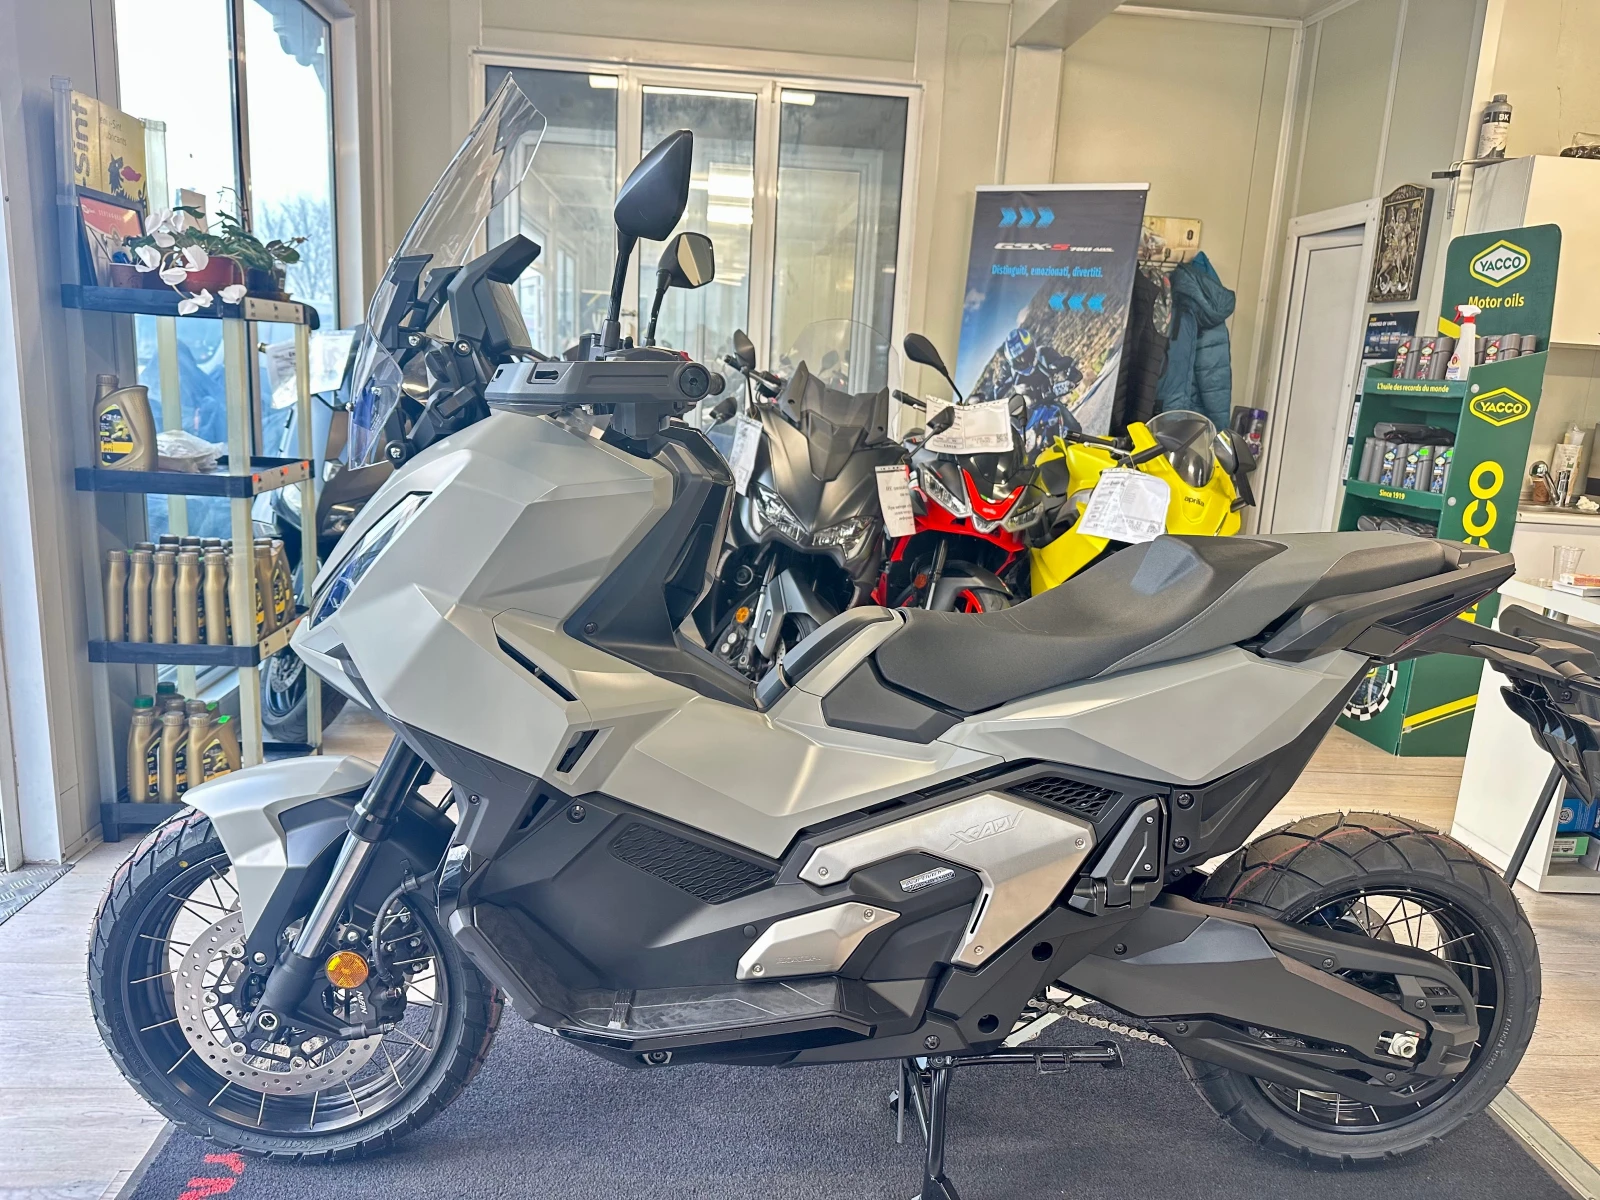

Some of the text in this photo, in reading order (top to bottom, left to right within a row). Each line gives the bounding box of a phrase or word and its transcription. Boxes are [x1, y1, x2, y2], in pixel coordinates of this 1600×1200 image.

[1480, 256, 1522, 272] YACCO
[991, 264, 1103, 279] Distinguiti, emozionati, divertiti.
[1468, 293, 1525, 309] Motor oils
[1377, 382, 1449, 393] L'huile des records du monde
[1480, 401, 1523, 414] YACCO
[1379, 489, 1406, 500] Since 1919
[1184, 496, 1205, 507] aprilia
